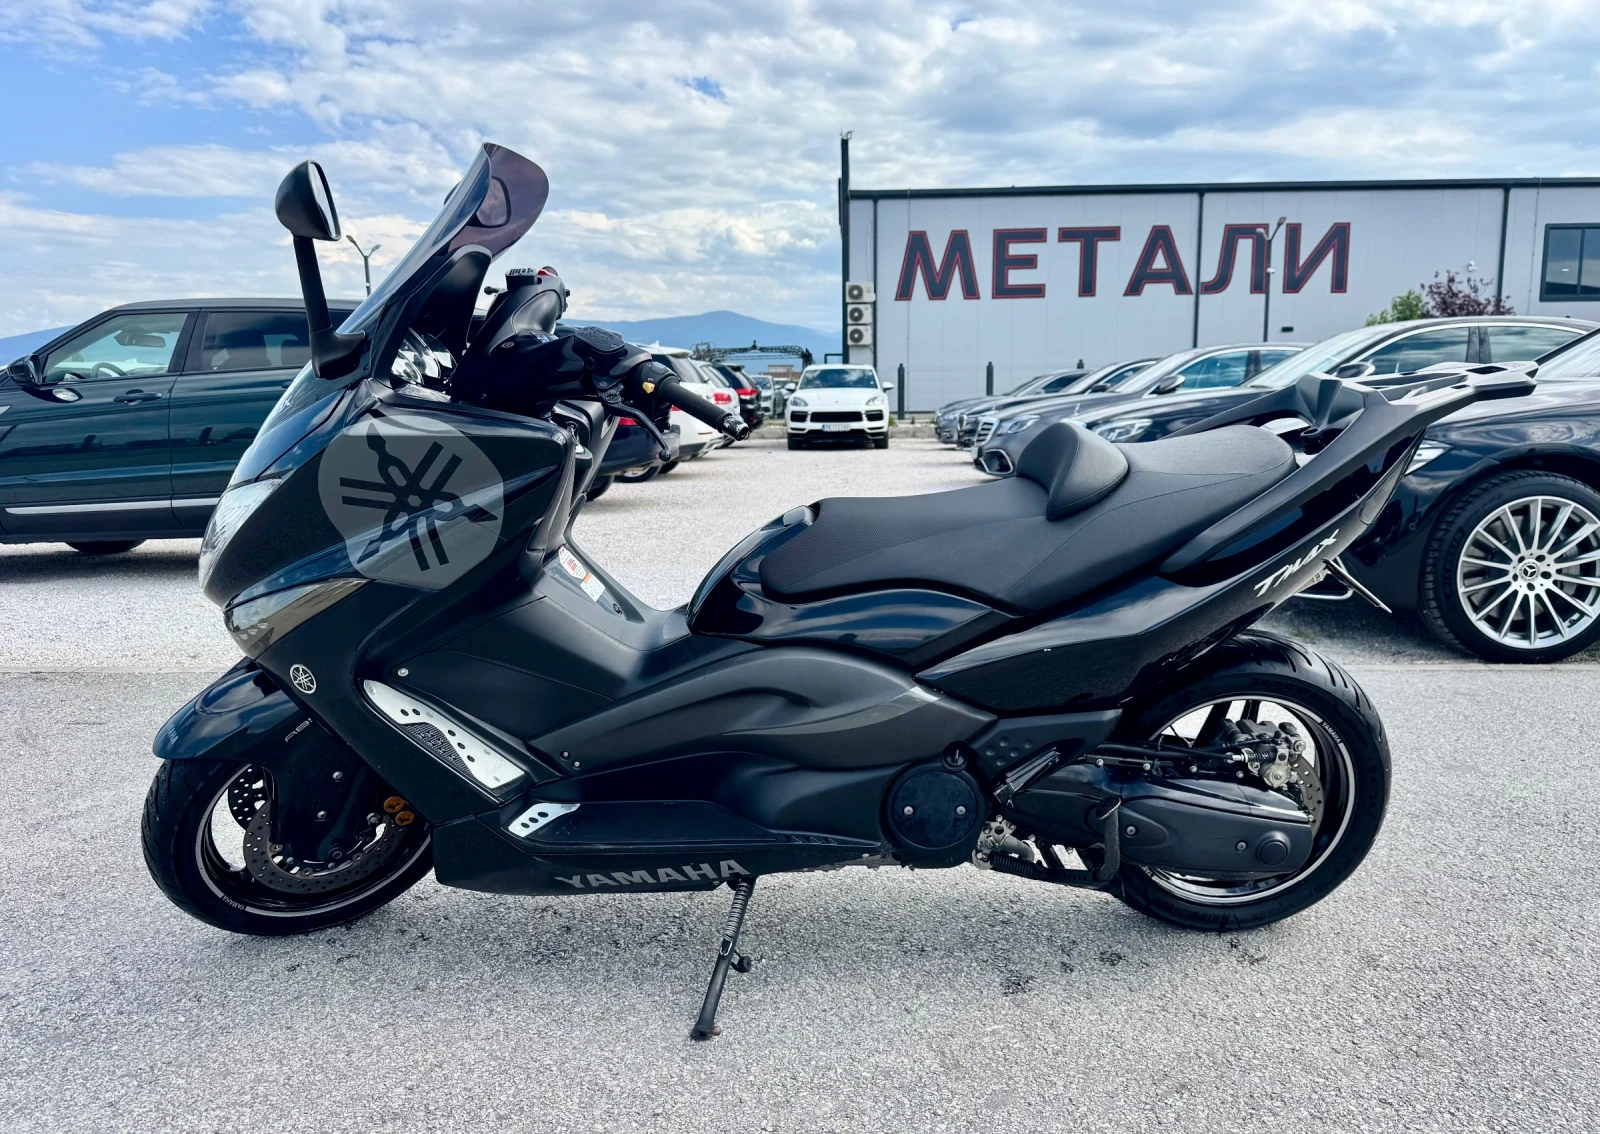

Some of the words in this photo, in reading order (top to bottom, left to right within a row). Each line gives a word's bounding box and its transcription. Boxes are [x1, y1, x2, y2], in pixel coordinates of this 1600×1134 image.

[894, 221, 1351, 301] МЕТАЛИ
[1321, 720, 1342, 744] YAMAHA
[553, 859, 751, 889] YAMAHA
[222, 894, 246, 911] YAMAHA
